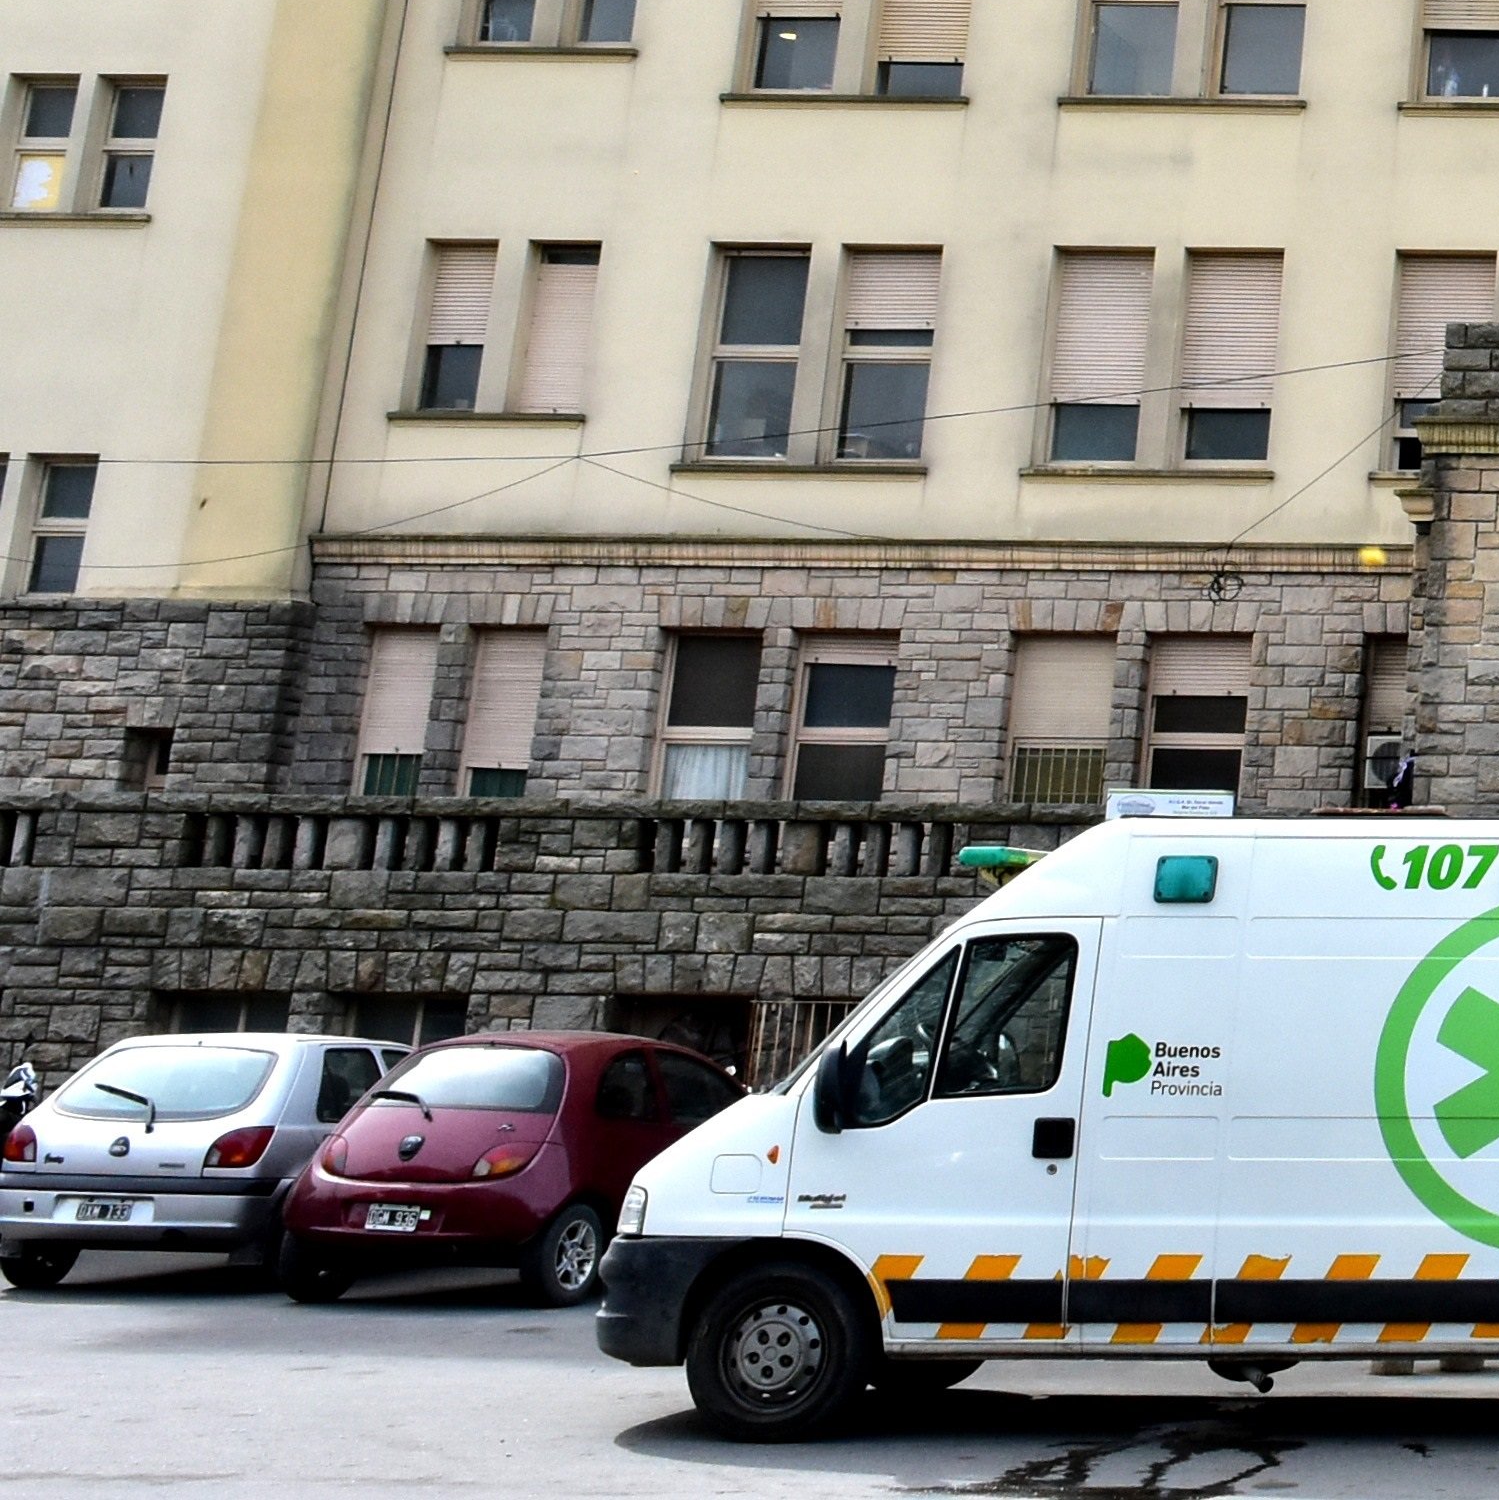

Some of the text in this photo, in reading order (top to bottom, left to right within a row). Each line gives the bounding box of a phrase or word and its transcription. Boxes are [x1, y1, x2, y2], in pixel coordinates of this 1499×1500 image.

[1154, 1041, 1221, 1058] Buenos
[1152, 1061, 1200, 1077] Aires
[1150, 1080, 1223, 1096] Provincia
[394, 1211, 417, 1227] 936
